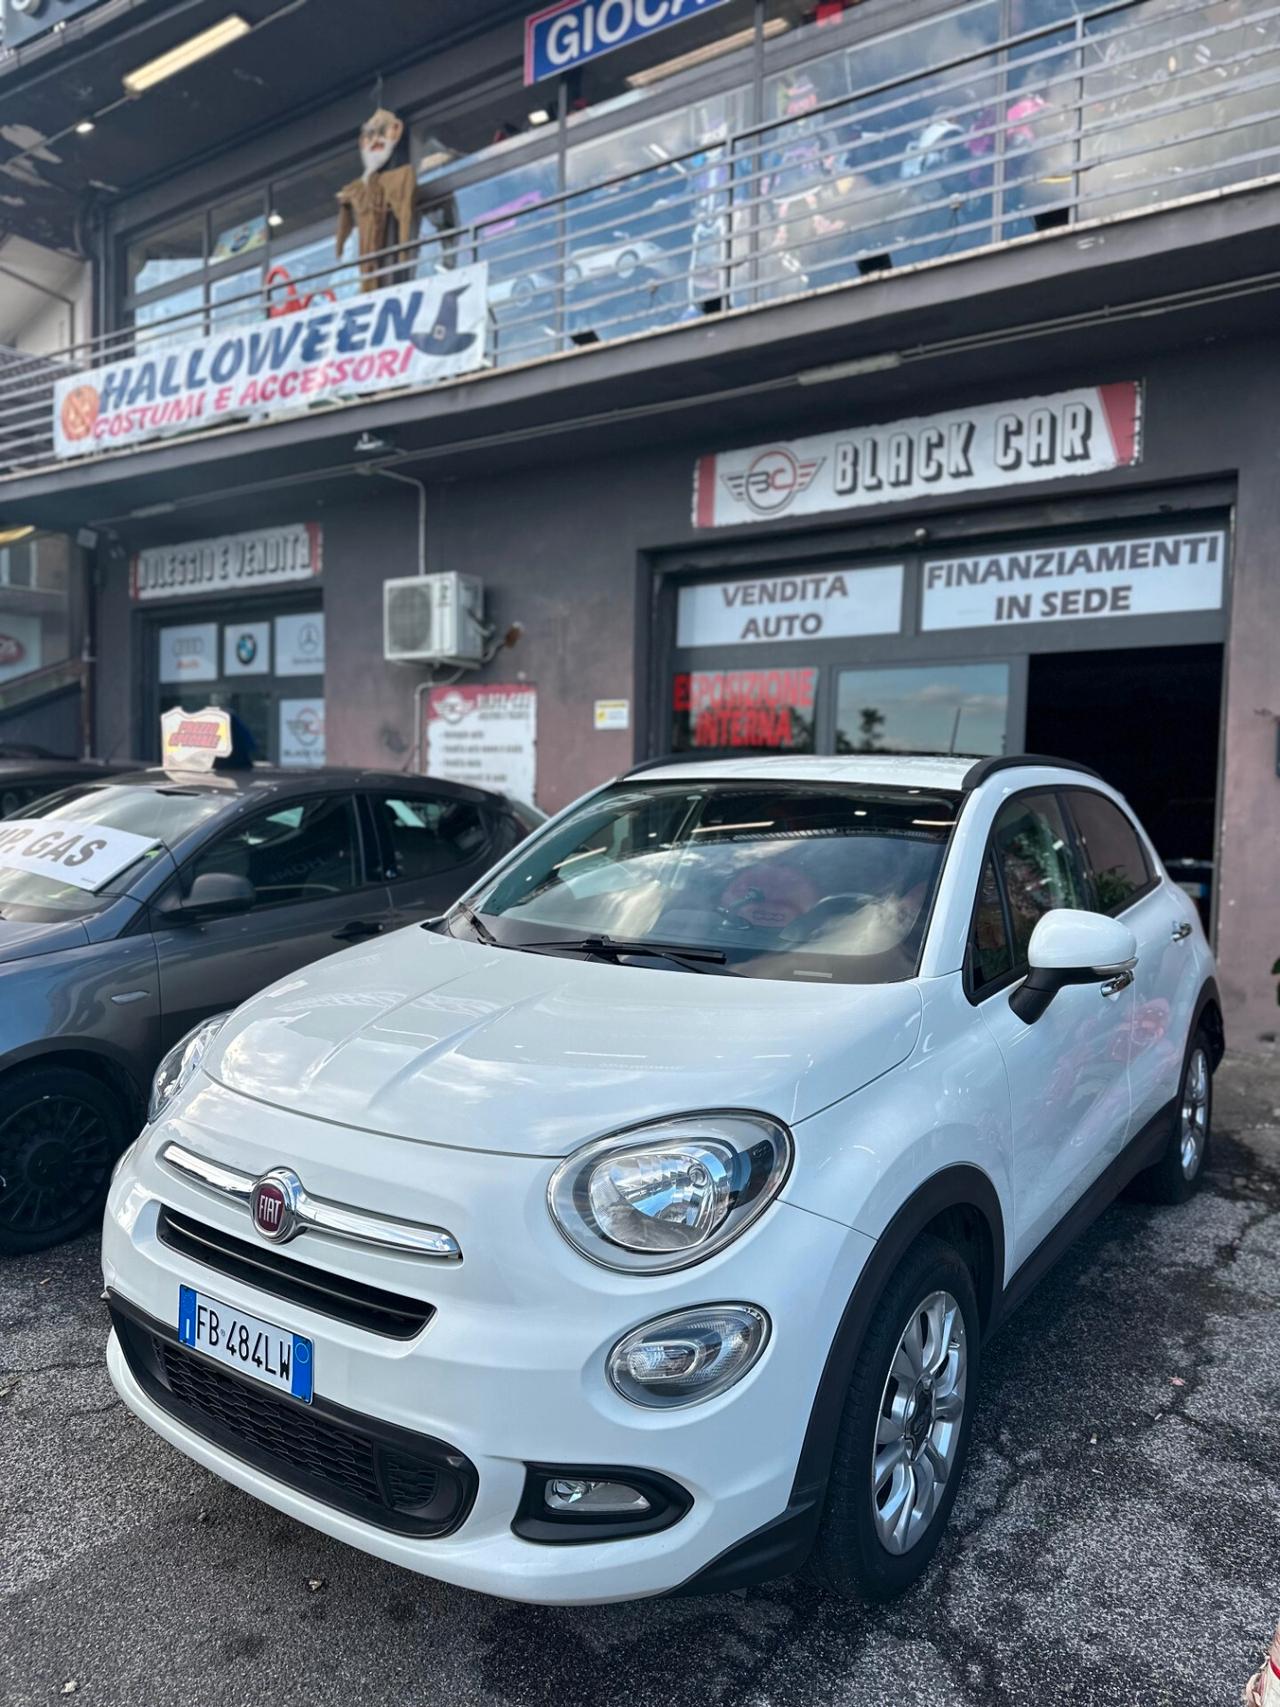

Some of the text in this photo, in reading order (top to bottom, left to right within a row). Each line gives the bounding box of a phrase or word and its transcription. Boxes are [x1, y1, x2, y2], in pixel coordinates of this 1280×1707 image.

[97, 290, 424, 414] HALLOWEEN
[92, 344, 416, 440] COSTUMI E ACCESSORI
[834, 402, 1094, 494] BLACK CAR
[926, 536, 1219, 590] FINANZIAMENTI
[722, 575, 849, 607] VENDITA
[995, 586, 1133, 622] IN SEDE
[741, 612, 823, 639] AUTO
[672, 667, 817, 712] ESPOSIZIONE
[694, 708, 794, 747] INTERNA
[22, 831, 108, 866] GAS
[259, 1194, 282, 1225] FIAT
